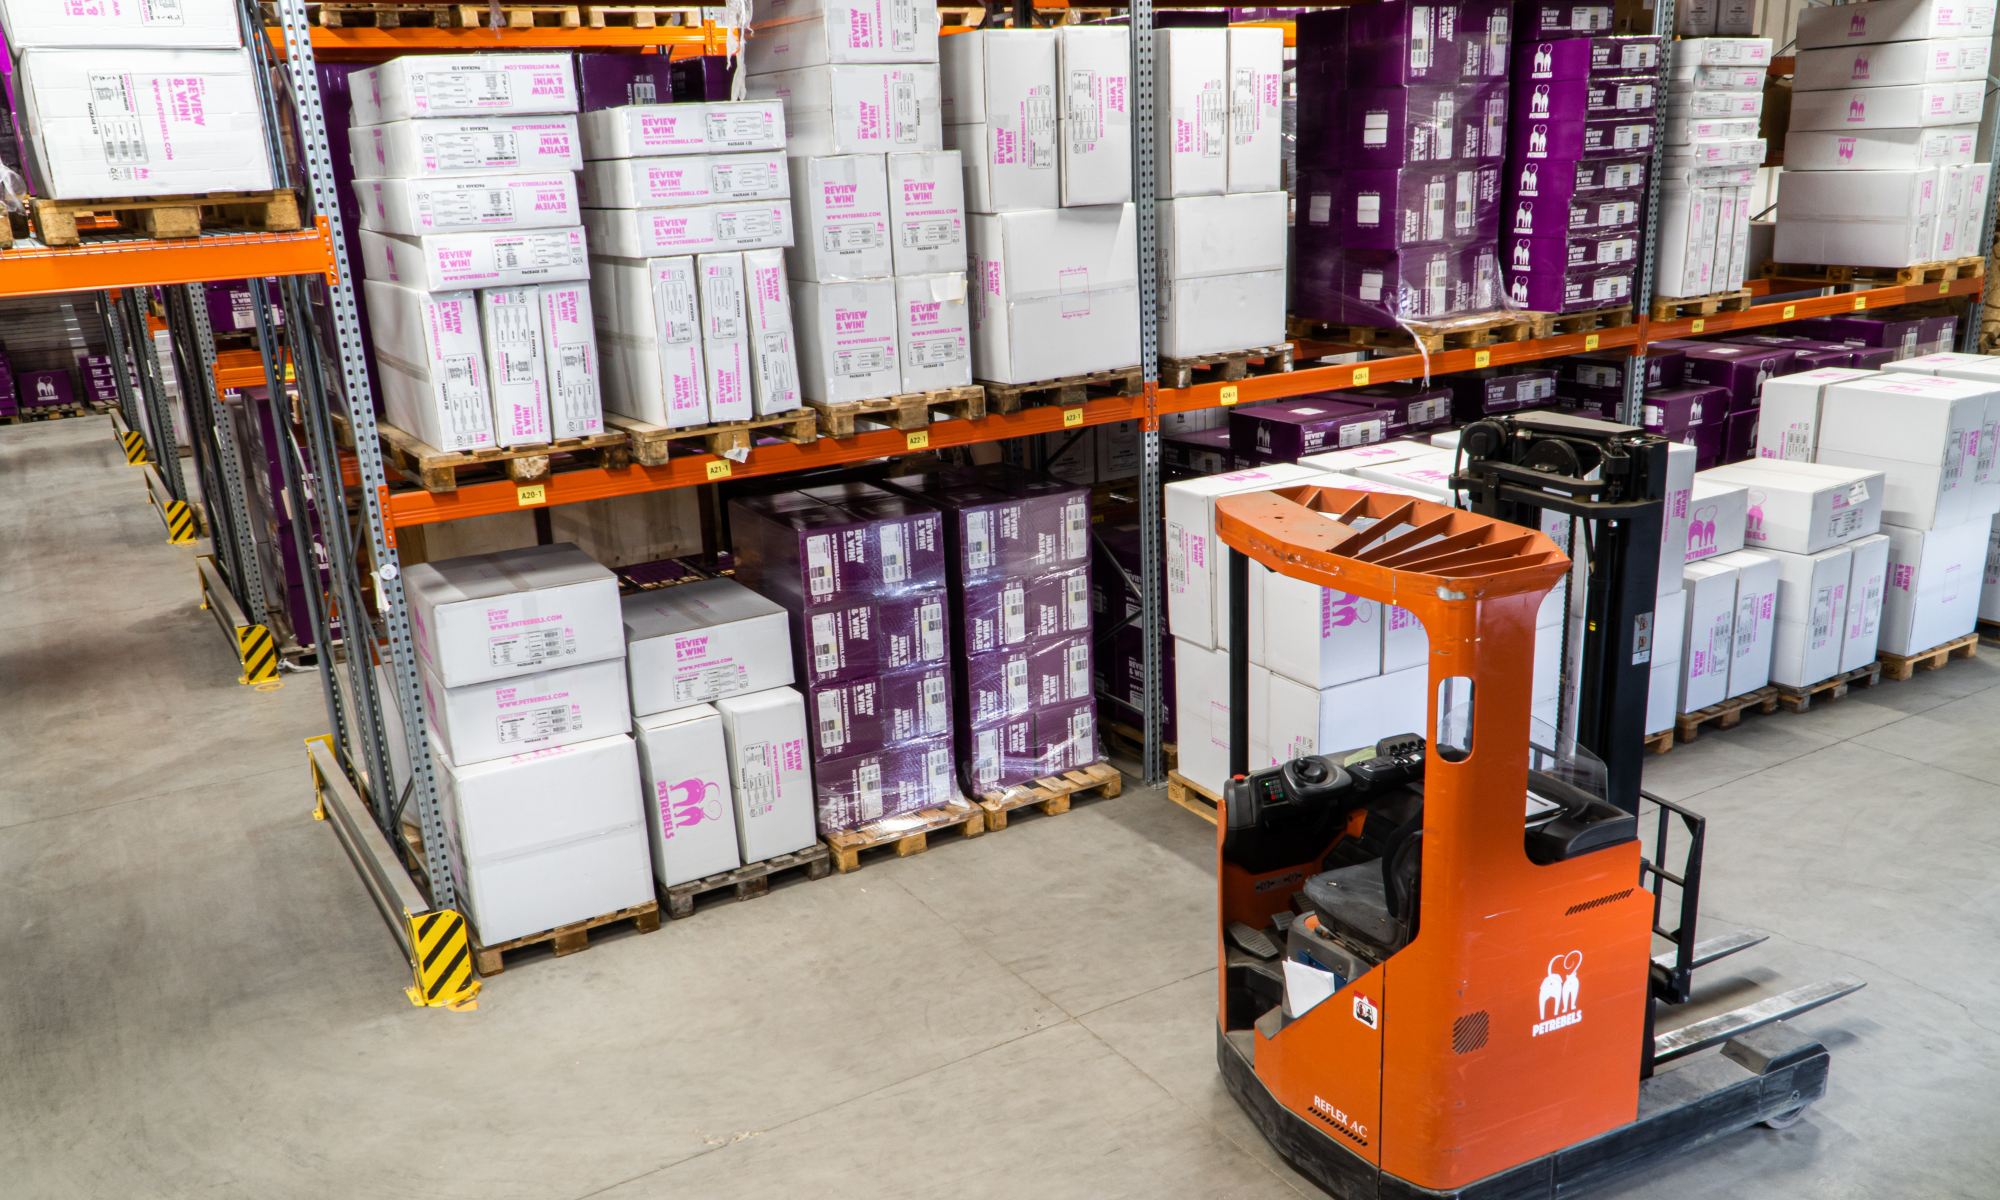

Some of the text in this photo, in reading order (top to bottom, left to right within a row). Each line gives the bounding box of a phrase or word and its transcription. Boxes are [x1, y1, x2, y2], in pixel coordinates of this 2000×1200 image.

[532, 86, 564, 95] REVIEW
[173, 79, 190, 122] & WIN!
[186, 78, 206, 126] REVIEW
[642, 118, 676, 126] REVIEW
[652, 126, 674, 135] WIN!
[538, 144, 570, 154] REVIEW
[649, 170, 683, 179] REVIEW
[659, 180, 681, 188] WIN!
[824, 184, 857, 194] REVIEW
[904, 182, 935, 192] REVIEW
[825, 194, 854, 204] & WIN!
[912, 192, 932, 201] WIN!
[534, 201, 568, 211] REVIEW
[654, 218, 688, 228] REVIEW
[664, 228, 686, 236] WIN!
[438, 250, 472, 260] REVIEW
[910, 302, 941, 312] REVIEW
[836, 310, 868, 321] REVIEW
[918, 312, 938, 320] WIN!
[836, 320, 864, 330] & WIN!
[674, 374, 682, 410] REVIEW
[1066, 413, 1081, 422] A23-1
[910, 436, 926, 444] A22-1
[710, 465, 729, 474] A21-1
[522, 490, 542, 500] A20-1
[926, 518, 934, 552] REVIEW
[855, 529, 864, 564] REVIEW
[1684, 546, 1718, 560] PETREBELS
[1322, 586, 1331, 638] ETREBELS
[860, 607, 869, 641] REVIEW
[675, 636, 708, 650] REVIEW
[686, 646, 706, 656] WIN!
[865, 683, 874, 716] REVIEW
[793, 740, 802, 771] REVIEW
[658, 780, 674, 840] PETREBELS
[1532, 1010, 1582, 1036] PETREBELS
[1314, 1096, 1368, 1138] REFLEX AC
